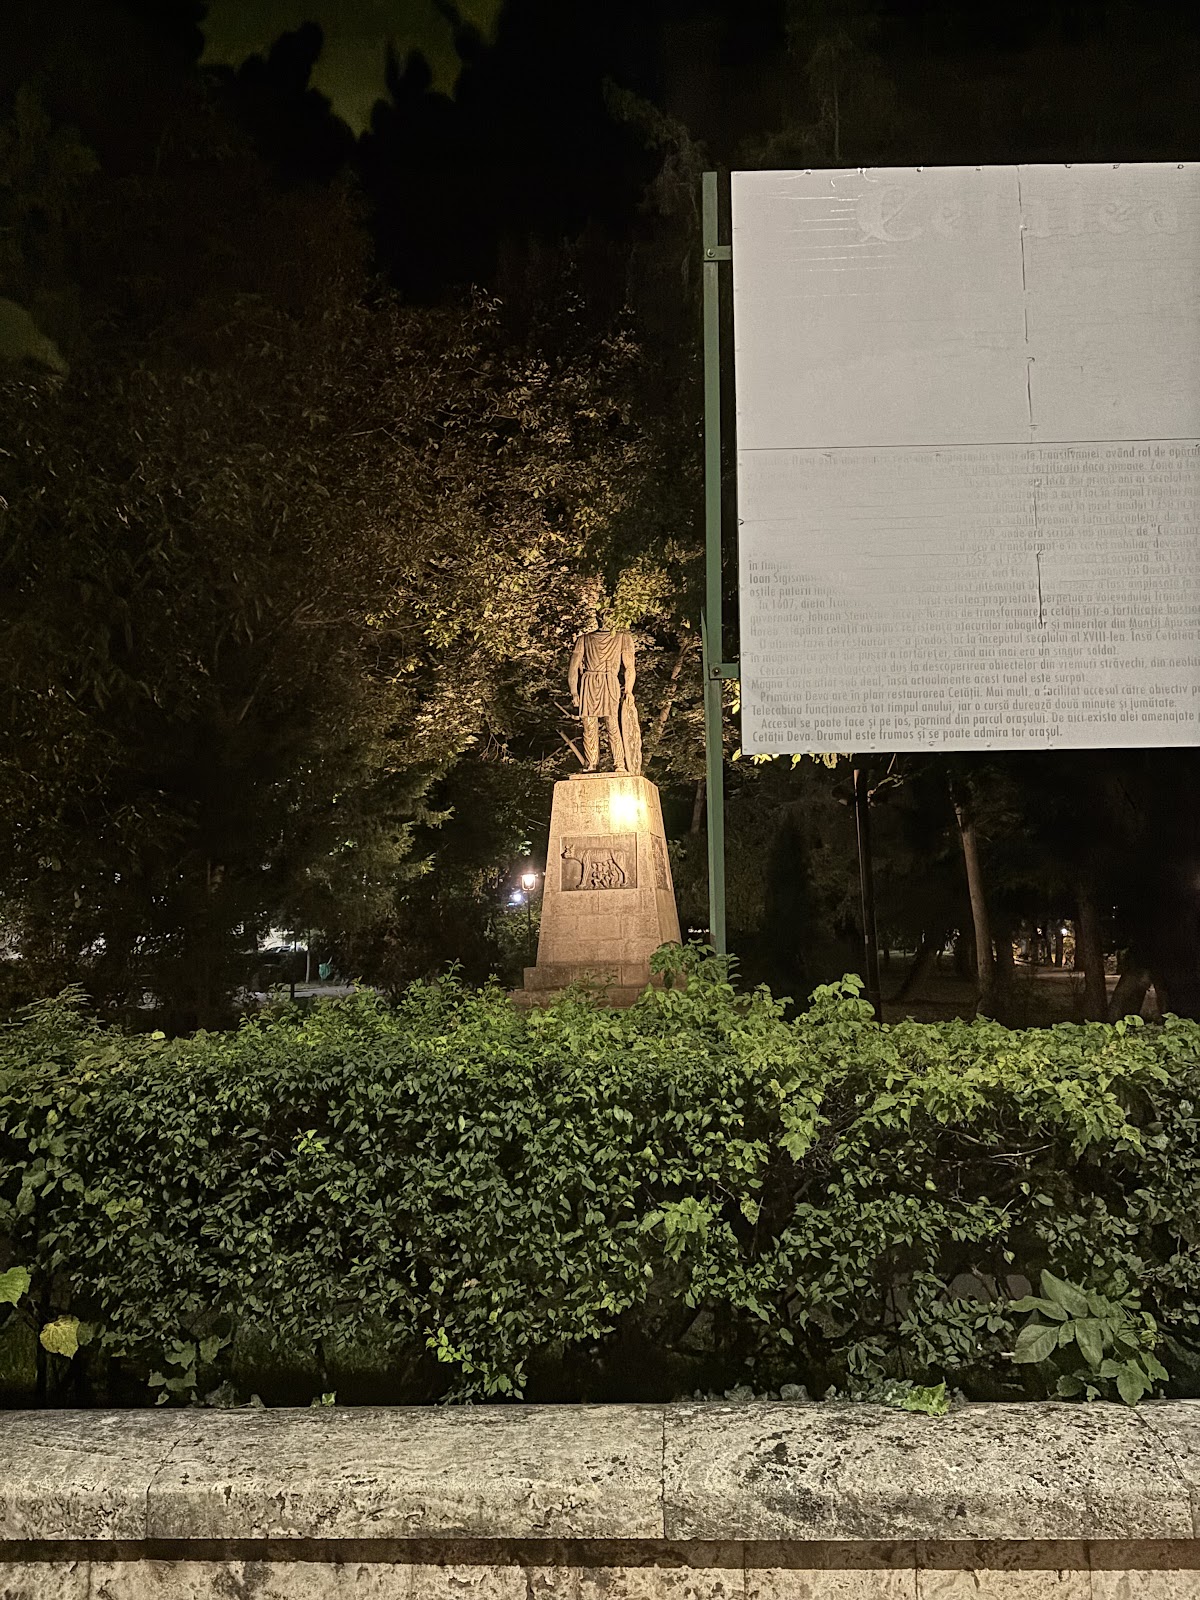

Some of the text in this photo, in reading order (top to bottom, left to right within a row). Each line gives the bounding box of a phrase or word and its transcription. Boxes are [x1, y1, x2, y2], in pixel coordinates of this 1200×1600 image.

[1105, 446, 1134, 457] având
[1137, 446, 1150, 456] rol
[1154, 445, 1165, 456] de
[1136, 523, 1147, 534] de
[749, 571, 770, 582] Ioan
[1063, 616, 1106, 628] minerilor
[1111, 615, 1125, 627] din
[978, 631, 1022, 646] începutul
[1070, 630, 1079, 641] al
[978, 646, 995, 656] aici
[998, 646, 1016, 656] mai
[1019, 647, 1035, 656] era
[1038, 647, 1050, 655] un
[1054, 644, 1083, 658] singur
[910, 660, 919, 672] la
[922, 659, 985, 674] descoperirea
[988, 658, 1036, 670] obiectelor
[1040, 657, 1055, 669] din
[910, 672, 971, 685] actualmente
[974, 673, 998, 684] acest
[1002, 671, 1027, 683] tunel
[1030, 672, 1051, 682] este
[805, 688, 829, 700] Deva
[850, 688, 859, 699] în
[863, 687, 884, 702] plan
[887, 687, 944, 698] restaurarea
[948, 685, 983, 700] Cetății.
[986, 685, 1003, 696] Mai
[1034, 687, 1039, 696] a
[1043, 683, 1079, 695] facilitat
[1083, 682, 1118, 694] accesul
[1149, 681, 1187, 693] obiectiv
[752, 695, 1177, 717] Telecabina funcționează tot timpul anului, iar o cursă durează două minute și jumătate.
[761, 716, 796, 728] Accesul
[800, 719, 810, 727] se
[814, 716, 841, 730] poate
[844, 714, 865, 726] face
[867, 715, 876, 729] și
[879, 717, 891, 729] pe
[894, 715, 910, 728] jos,
[913, 713, 951, 728] pornind
[954, 712, 970, 724] din
[972, 712, 1002, 727] parcul
[1005, 711, 1048, 726] orașului.
[1051, 710, 1064, 722] De
[1067, 711, 1084, 722] aici
[1120, 709, 1138, 721] alei
[1141, 709, 1194, 723] amenajate
[752, 729, 783, 745] Cetății
[786, 729, 813, 741] Deva.
[816, 728, 852, 740] Drumul
[855, 729, 876, 740] este
[879, 727, 914, 739] frumos
[917, 728, 925, 742] și
[928, 730, 939, 738] se
[942, 727, 970, 741] poate
[973, 725, 1008, 737] admira
[1028, 724, 1062, 739] orașul.
